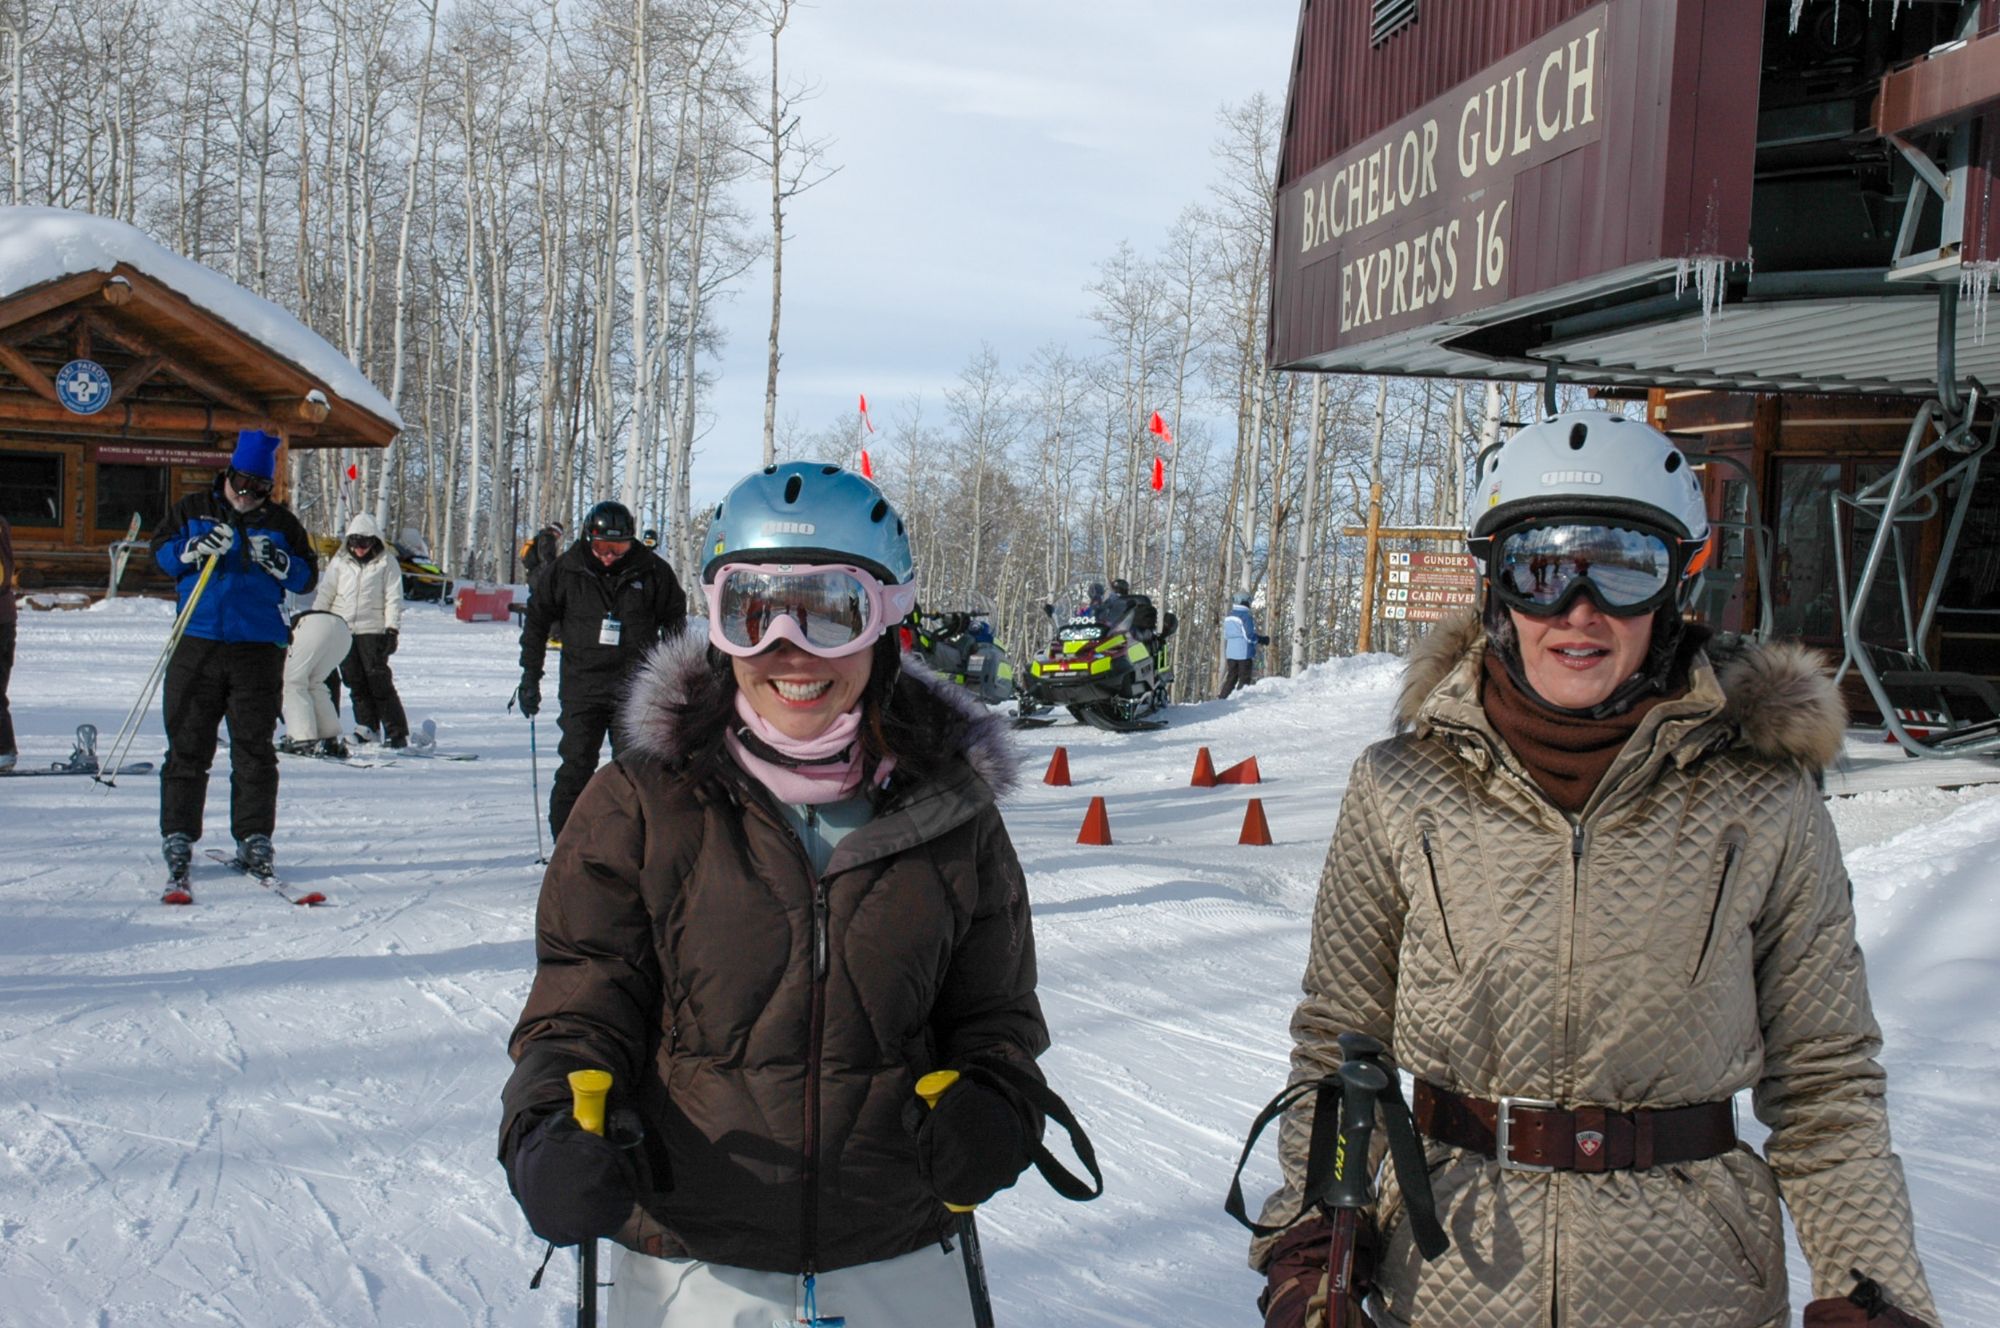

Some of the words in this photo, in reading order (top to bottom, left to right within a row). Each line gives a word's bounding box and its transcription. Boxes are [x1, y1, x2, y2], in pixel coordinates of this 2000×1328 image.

[1301, 119, 1438, 253] BACHELOR
[1458, 28, 1599, 178] GULCH
[1340, 219, 1460, 333] EXPRESS
[1472, 200, 1507, 291] 16
[60, 365, 74, 380] SKI
[77, 362, 106, 381] PATROL
[1423, 555, 1469, 566] GUNDER'S
[1411, 590, 1443, 602] CABIN
[1068, 616, 1097, 625] 9904
